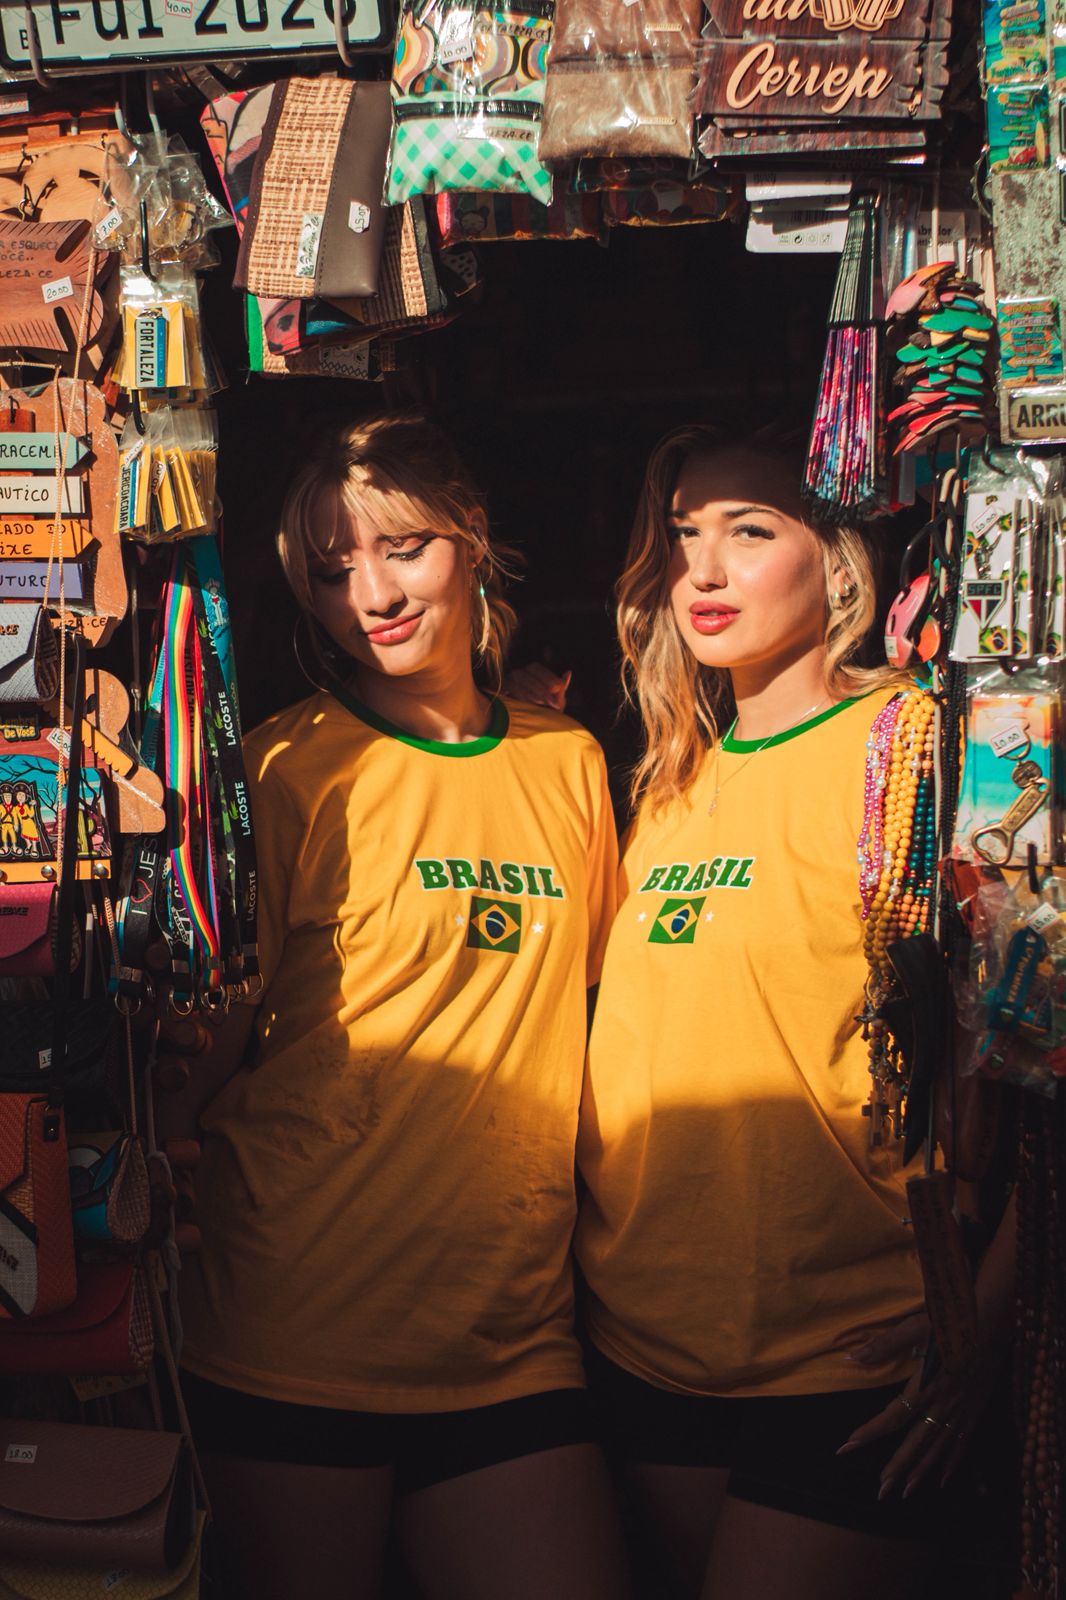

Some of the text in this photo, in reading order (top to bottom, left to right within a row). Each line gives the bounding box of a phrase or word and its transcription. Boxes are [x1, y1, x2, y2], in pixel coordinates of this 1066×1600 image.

[726, 42, 893, 115] Cerveja
[140, 321, 154, 383] FORTALEZA
[967, 583, 1001, 595] SPFC
[218, 691, 237, 746] LACOSTE
[994, 732, 1020, 749] 10.00
[235, 781, 251, 836] LACOSTE
[247, 870, 256, 921] LACOSTE
[414, 858, 565, 898] BRASIL
[638, 856, 756, 894] BRASIL
